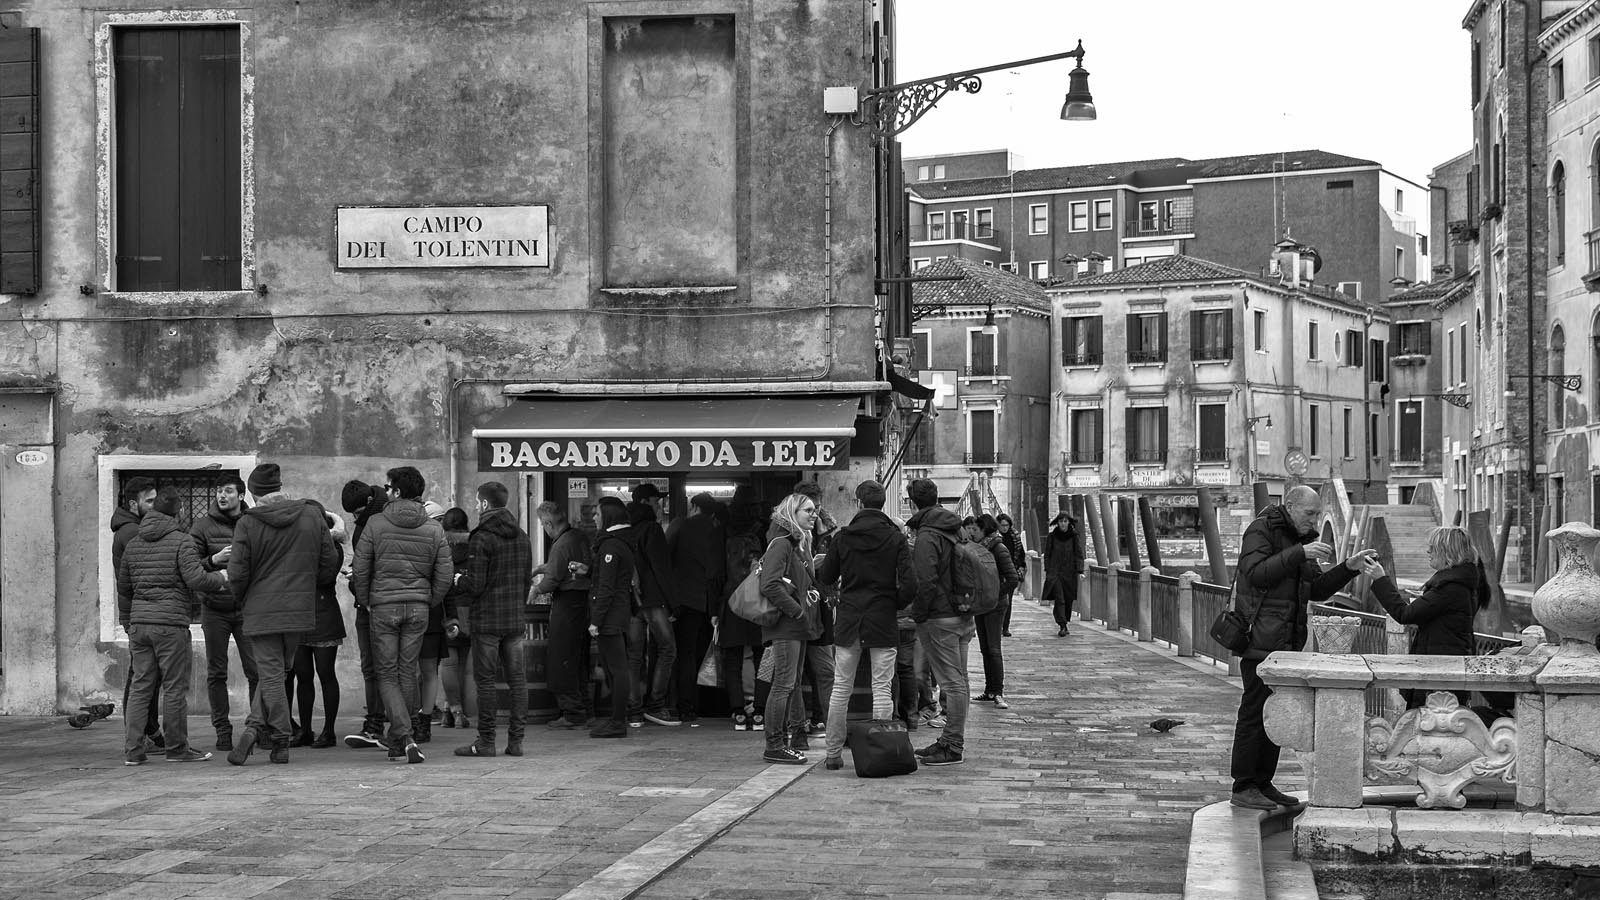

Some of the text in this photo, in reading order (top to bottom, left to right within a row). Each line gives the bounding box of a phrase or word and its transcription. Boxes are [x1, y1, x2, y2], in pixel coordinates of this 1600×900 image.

[403, 216, 483, 234] CAMPO
[346, 239, 540, 258] DEI TOLENTINI
[490, 440, 836, 467] BACARETO DA LELE
